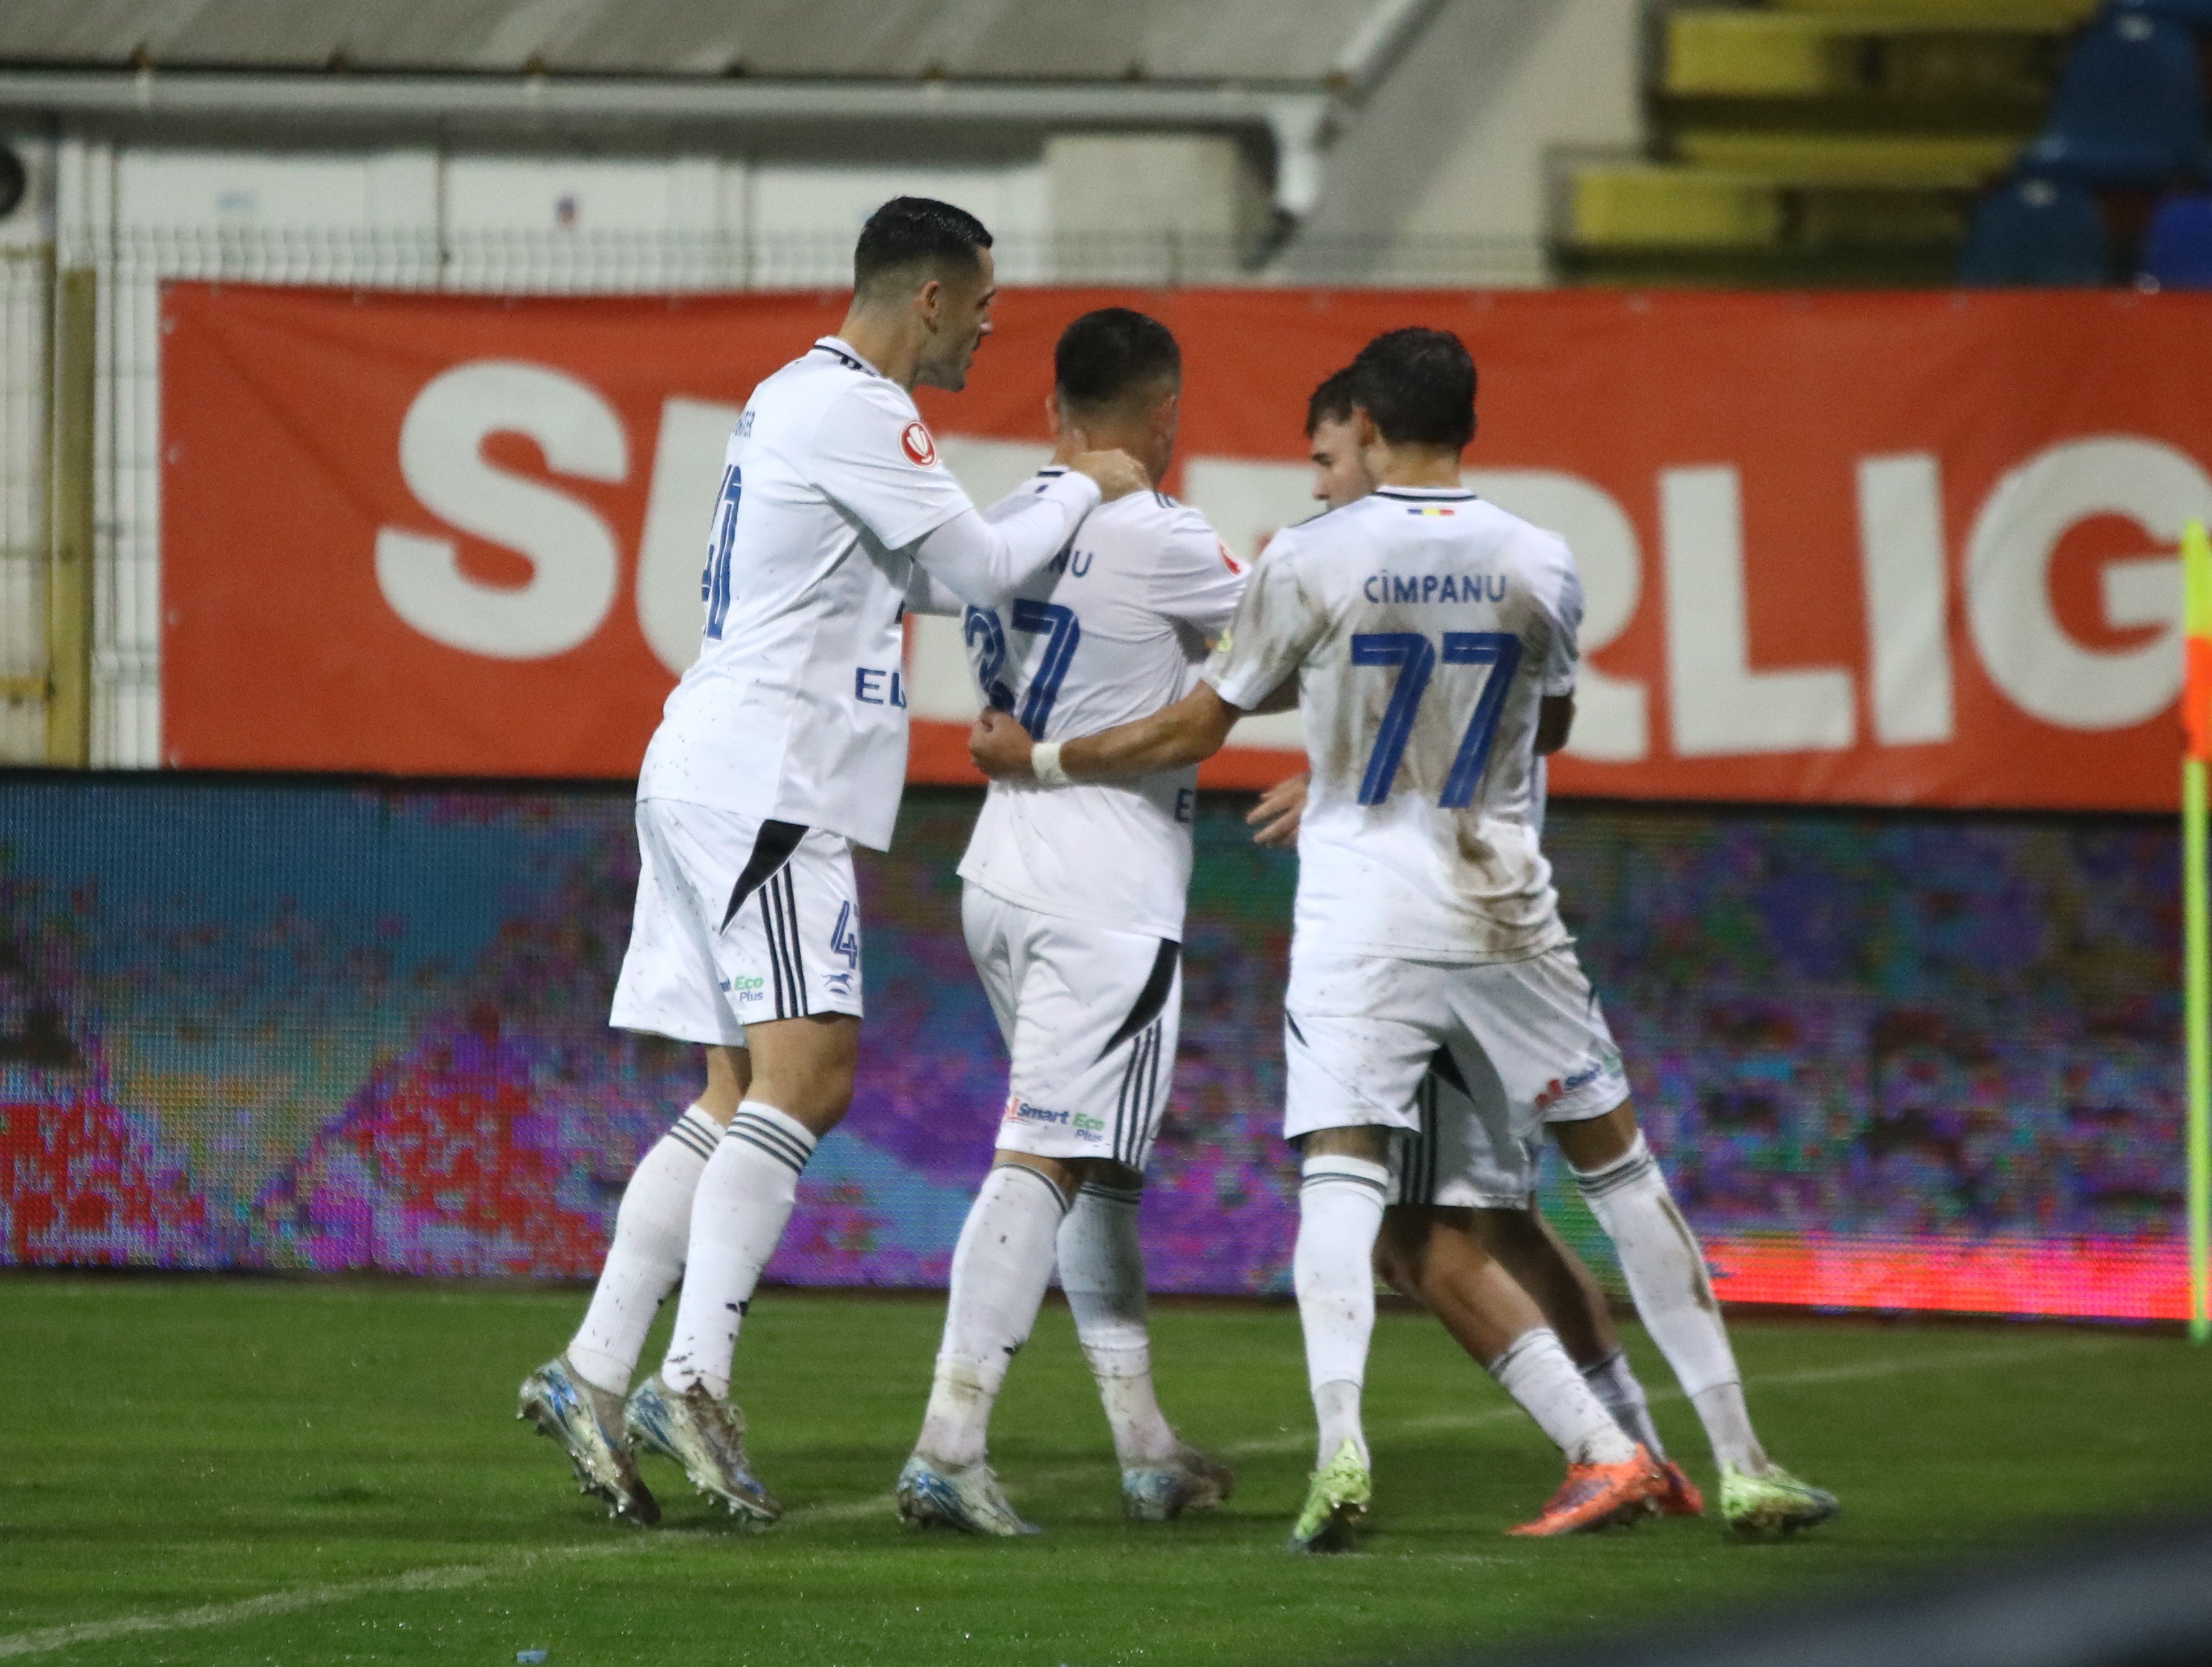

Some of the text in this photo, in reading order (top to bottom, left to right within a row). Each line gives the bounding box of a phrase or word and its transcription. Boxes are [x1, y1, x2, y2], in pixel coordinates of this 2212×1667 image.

[1350, 631, 1522, 809] 77
[830, 900, 859, 970] 4
[734, 975, 764, 991] Eco
[739, 990, 763, 1002] Plus
[1072, 1112, 1105, 1131] Eco
